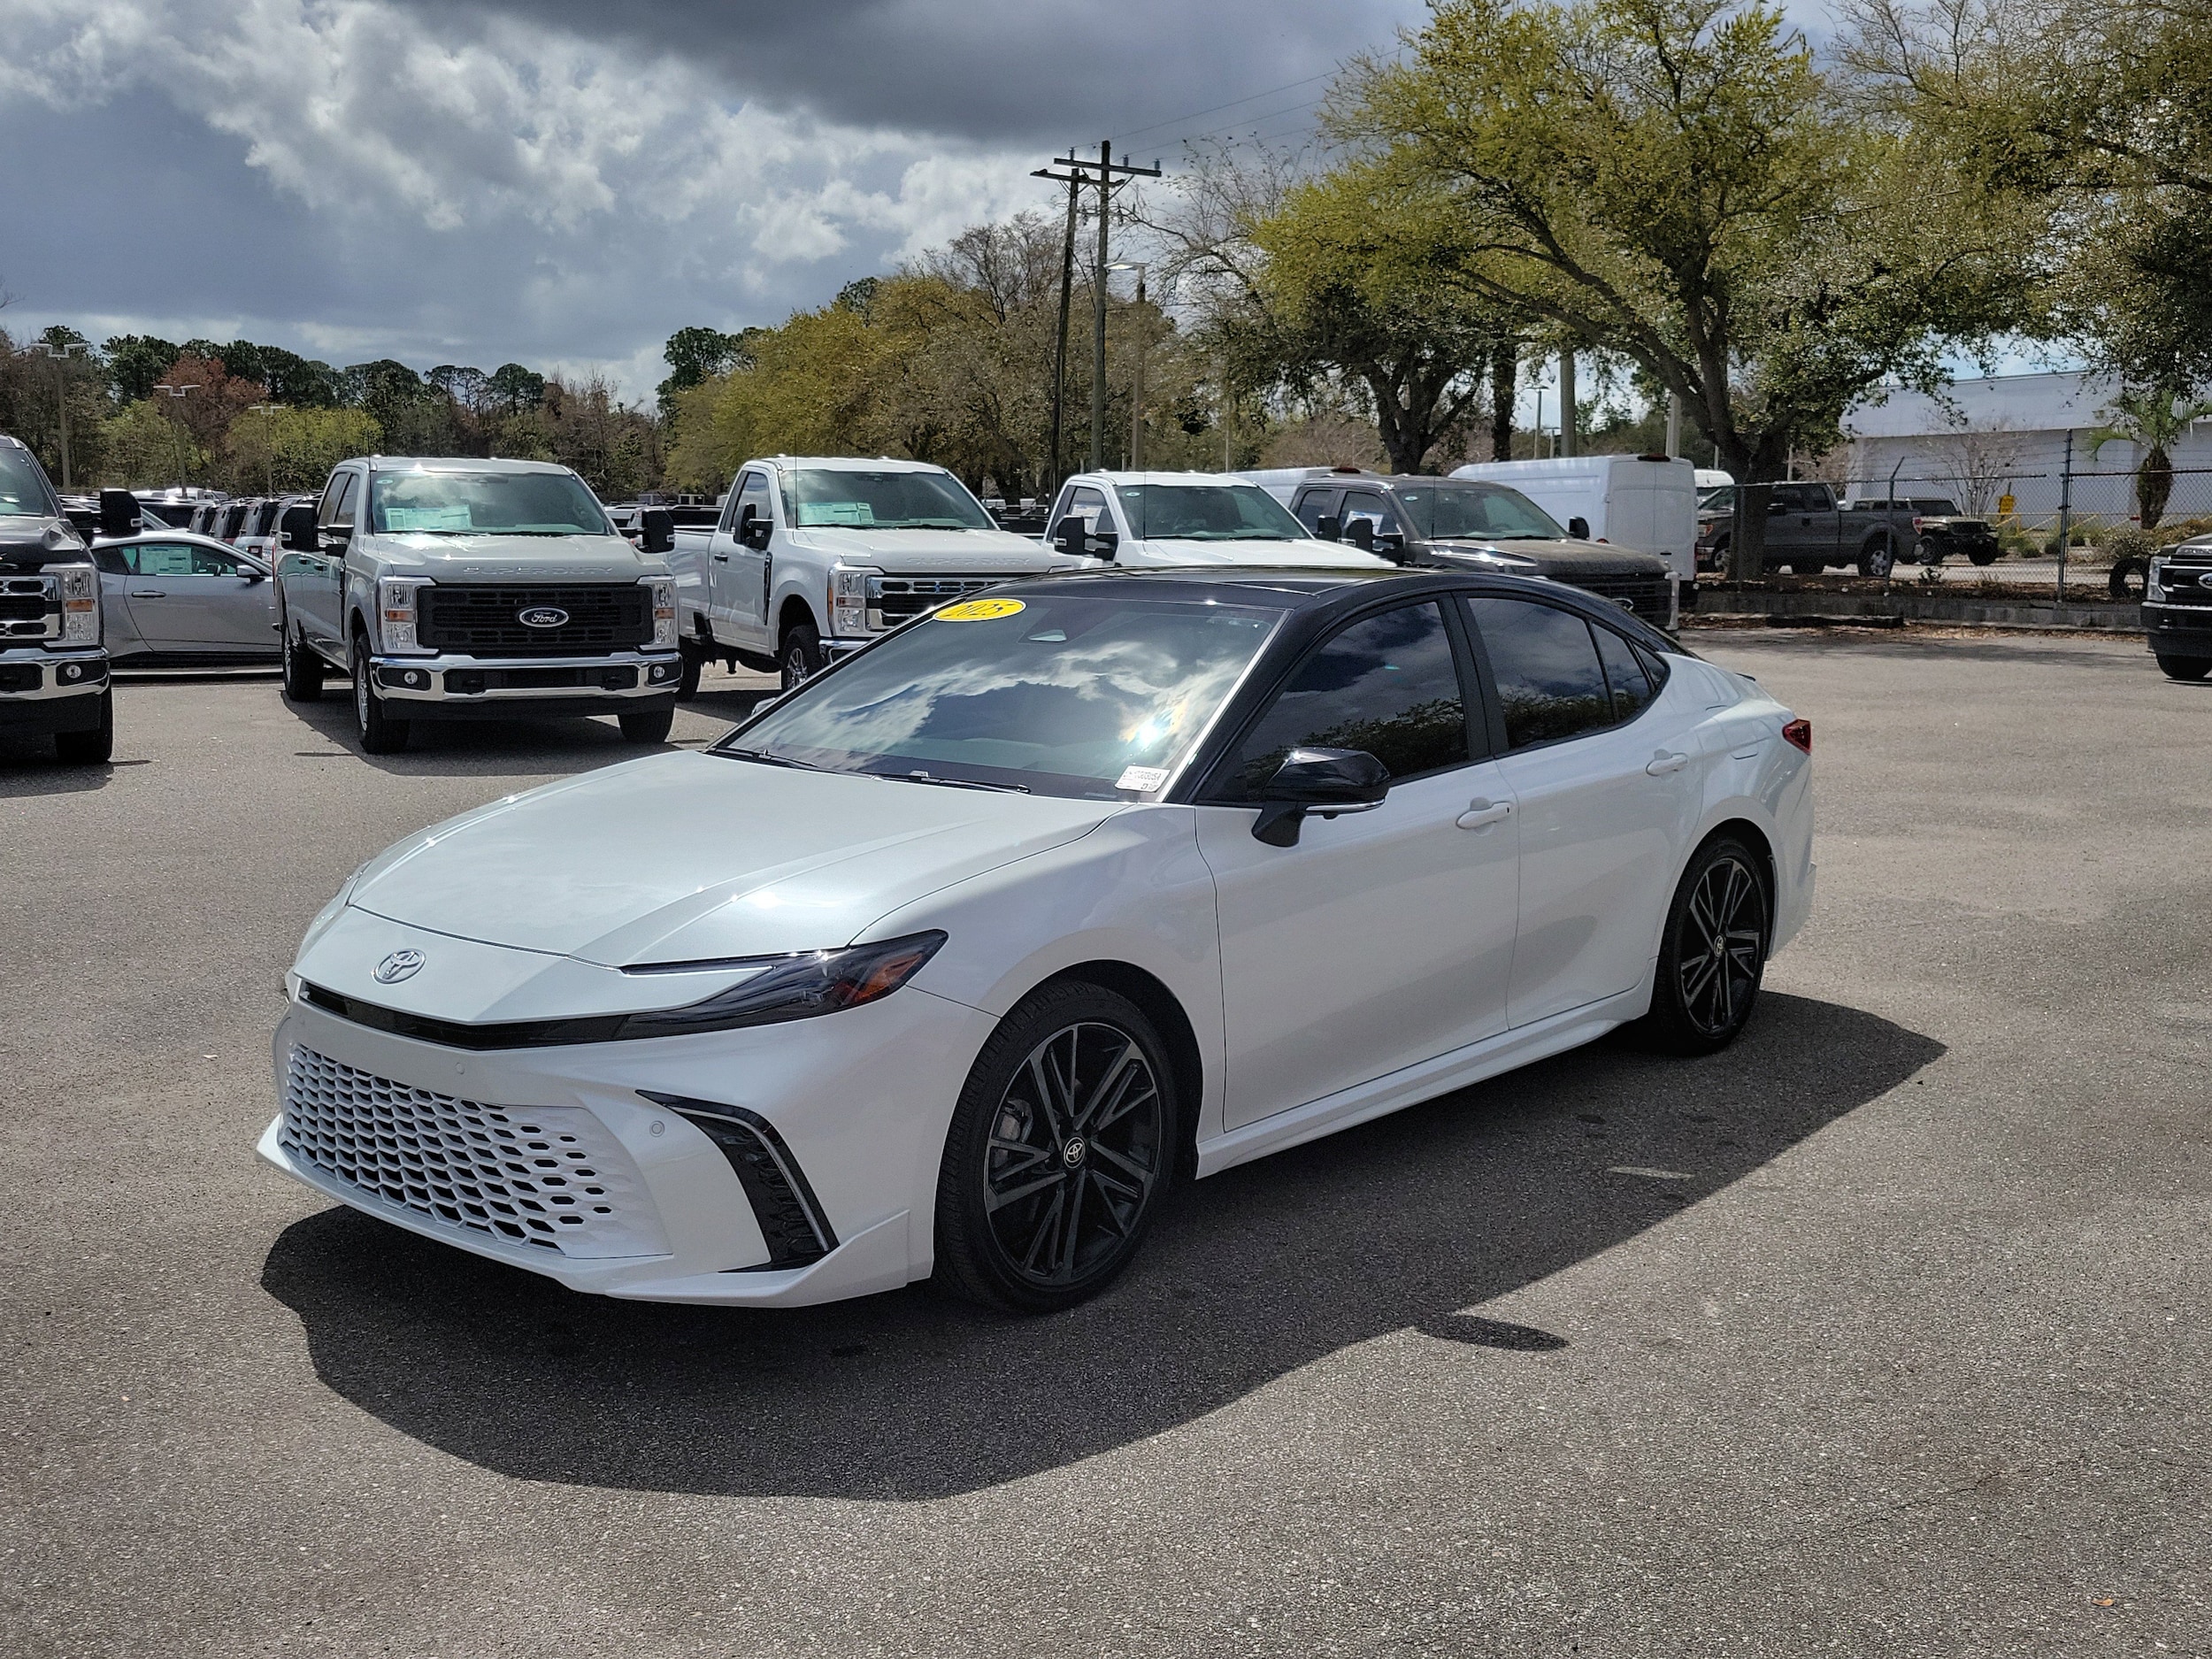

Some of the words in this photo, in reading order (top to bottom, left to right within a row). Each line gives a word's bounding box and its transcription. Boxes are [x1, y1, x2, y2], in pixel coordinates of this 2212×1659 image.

[463, 566, 548, 575] SUPER
[552, 566, 613, 575] DUTY
[939, 603, 1016, 618] 2025
[531, 611, 558, 623] Ford
